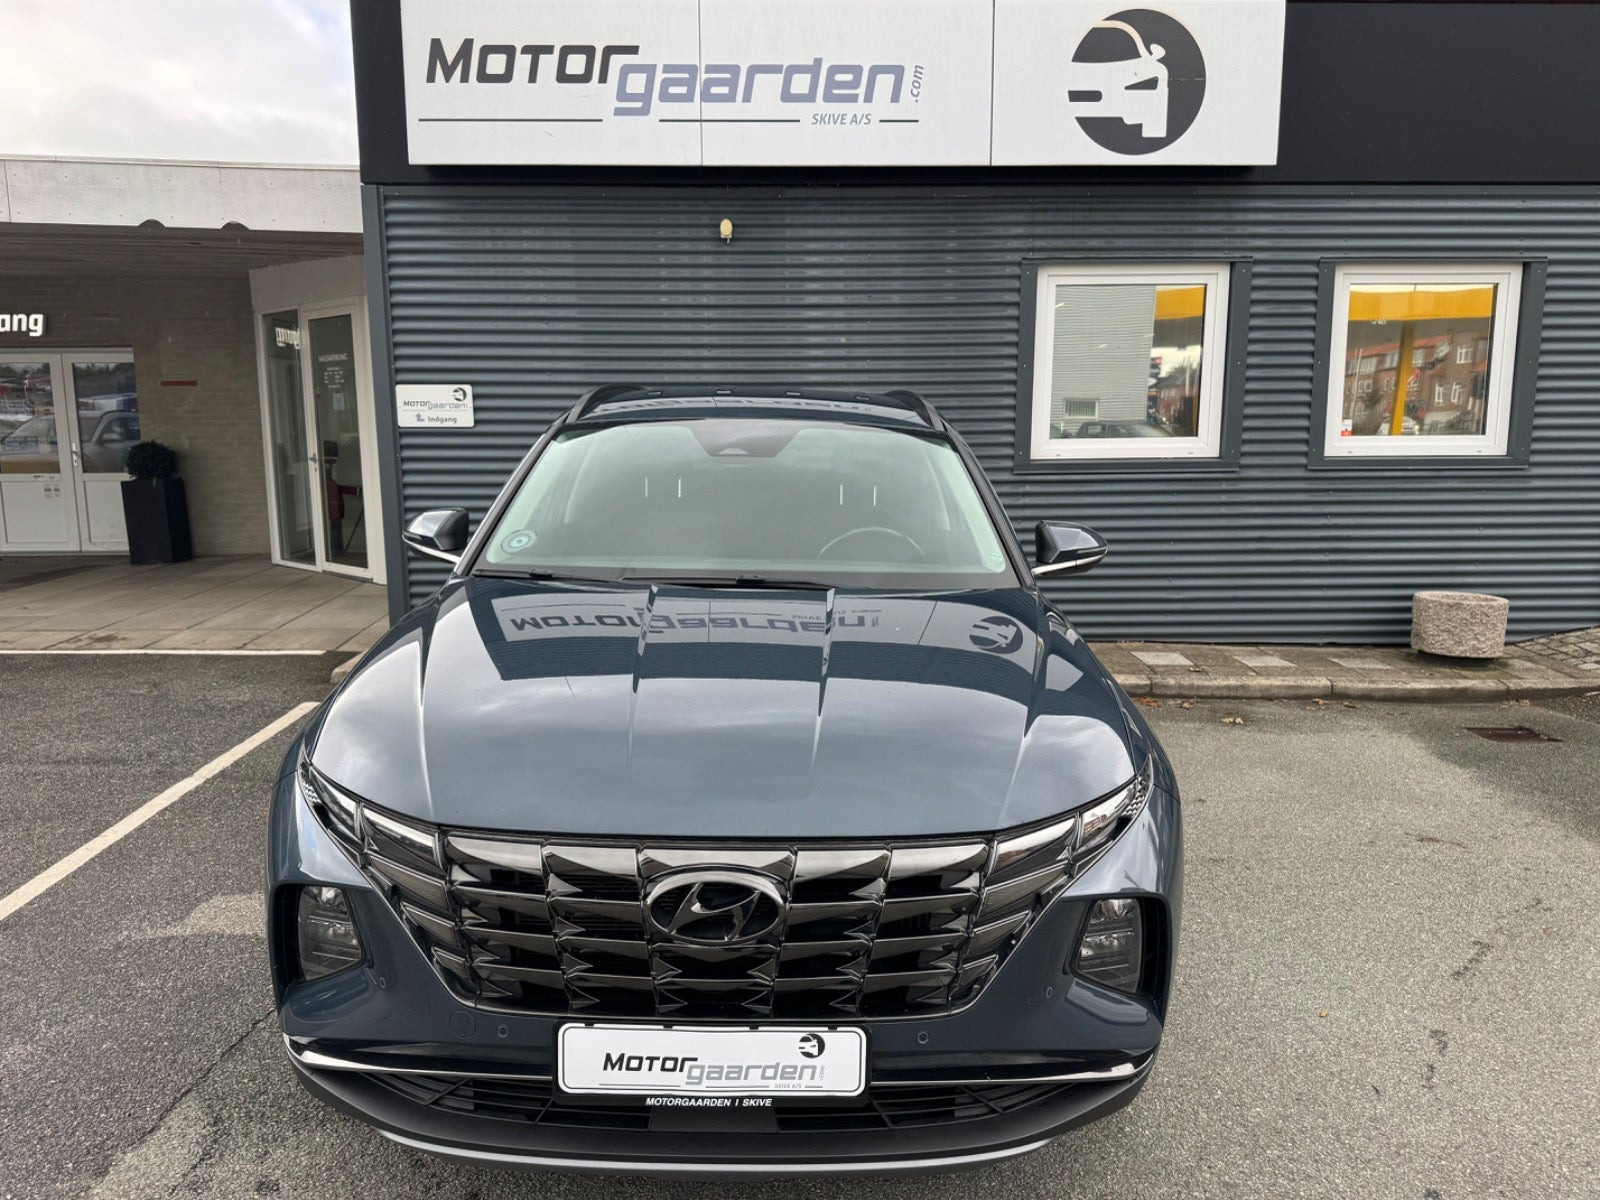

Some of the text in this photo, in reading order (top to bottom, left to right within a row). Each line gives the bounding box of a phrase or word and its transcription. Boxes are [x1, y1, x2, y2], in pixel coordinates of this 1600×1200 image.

[911, 64, 925, 104] .com
[811, 112, 872, 126] SKIVE A/S
[645, 1097, 732, 1107] MOTORGAARDEN
[742, 1098, 773, 1107] SKIVE
